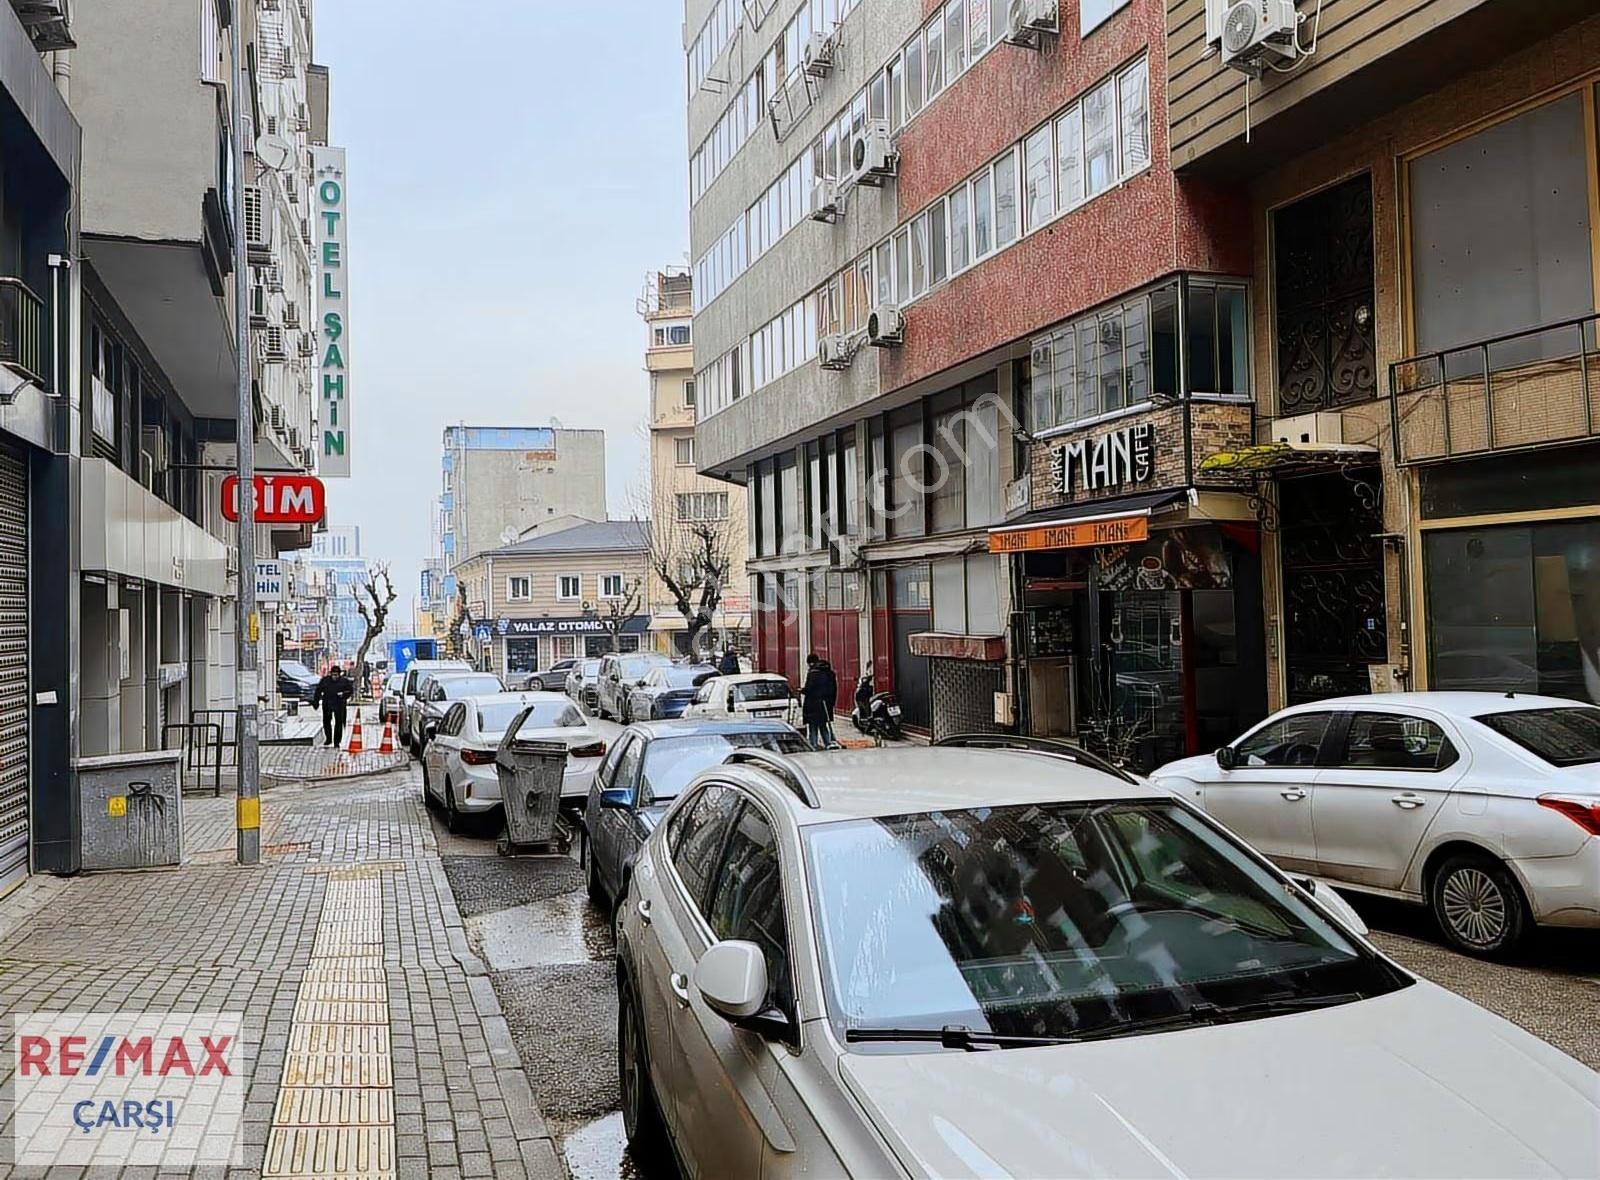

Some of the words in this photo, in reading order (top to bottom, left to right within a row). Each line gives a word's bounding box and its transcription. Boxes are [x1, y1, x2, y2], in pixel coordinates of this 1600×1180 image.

[319, 180, 341, 299] OTEL
[321, 312, 345, 456] ŞAHİN
[1051, 445, 1063, 493] KARA
[1064, 428, 1131, 493] MAN
[1135, 423, 1149, 481] CAFE
[255, 564, 281, 576] TEL
[513, 622, 554, 631] YALAZ
